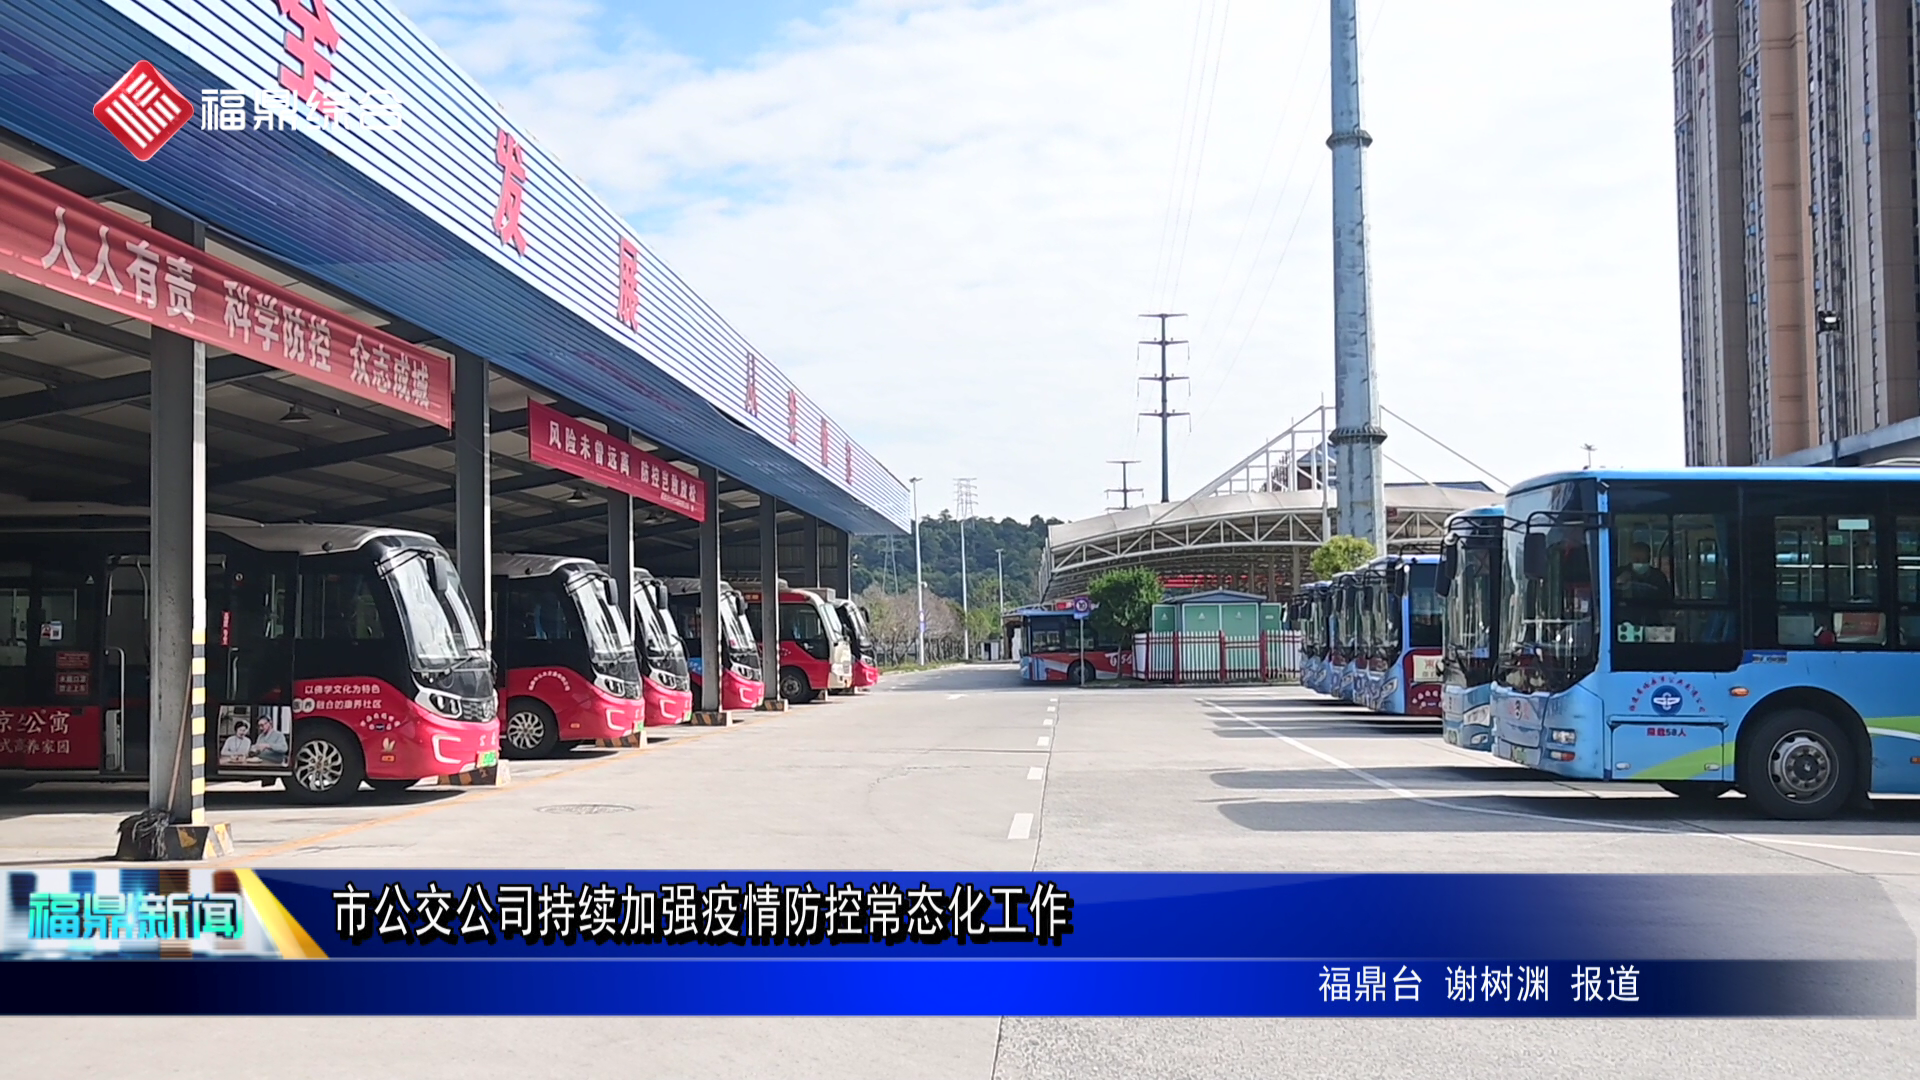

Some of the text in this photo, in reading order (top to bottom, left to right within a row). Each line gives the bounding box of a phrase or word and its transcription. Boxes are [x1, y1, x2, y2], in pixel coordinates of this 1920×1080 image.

[40, 205, 431, 411] 人人有责 科学防控 众志成城
[549, 420, 698, 503] 风险未曾远离 防控岂敢放松
[304, 684, 381, 695] 以佛学文化为特色
